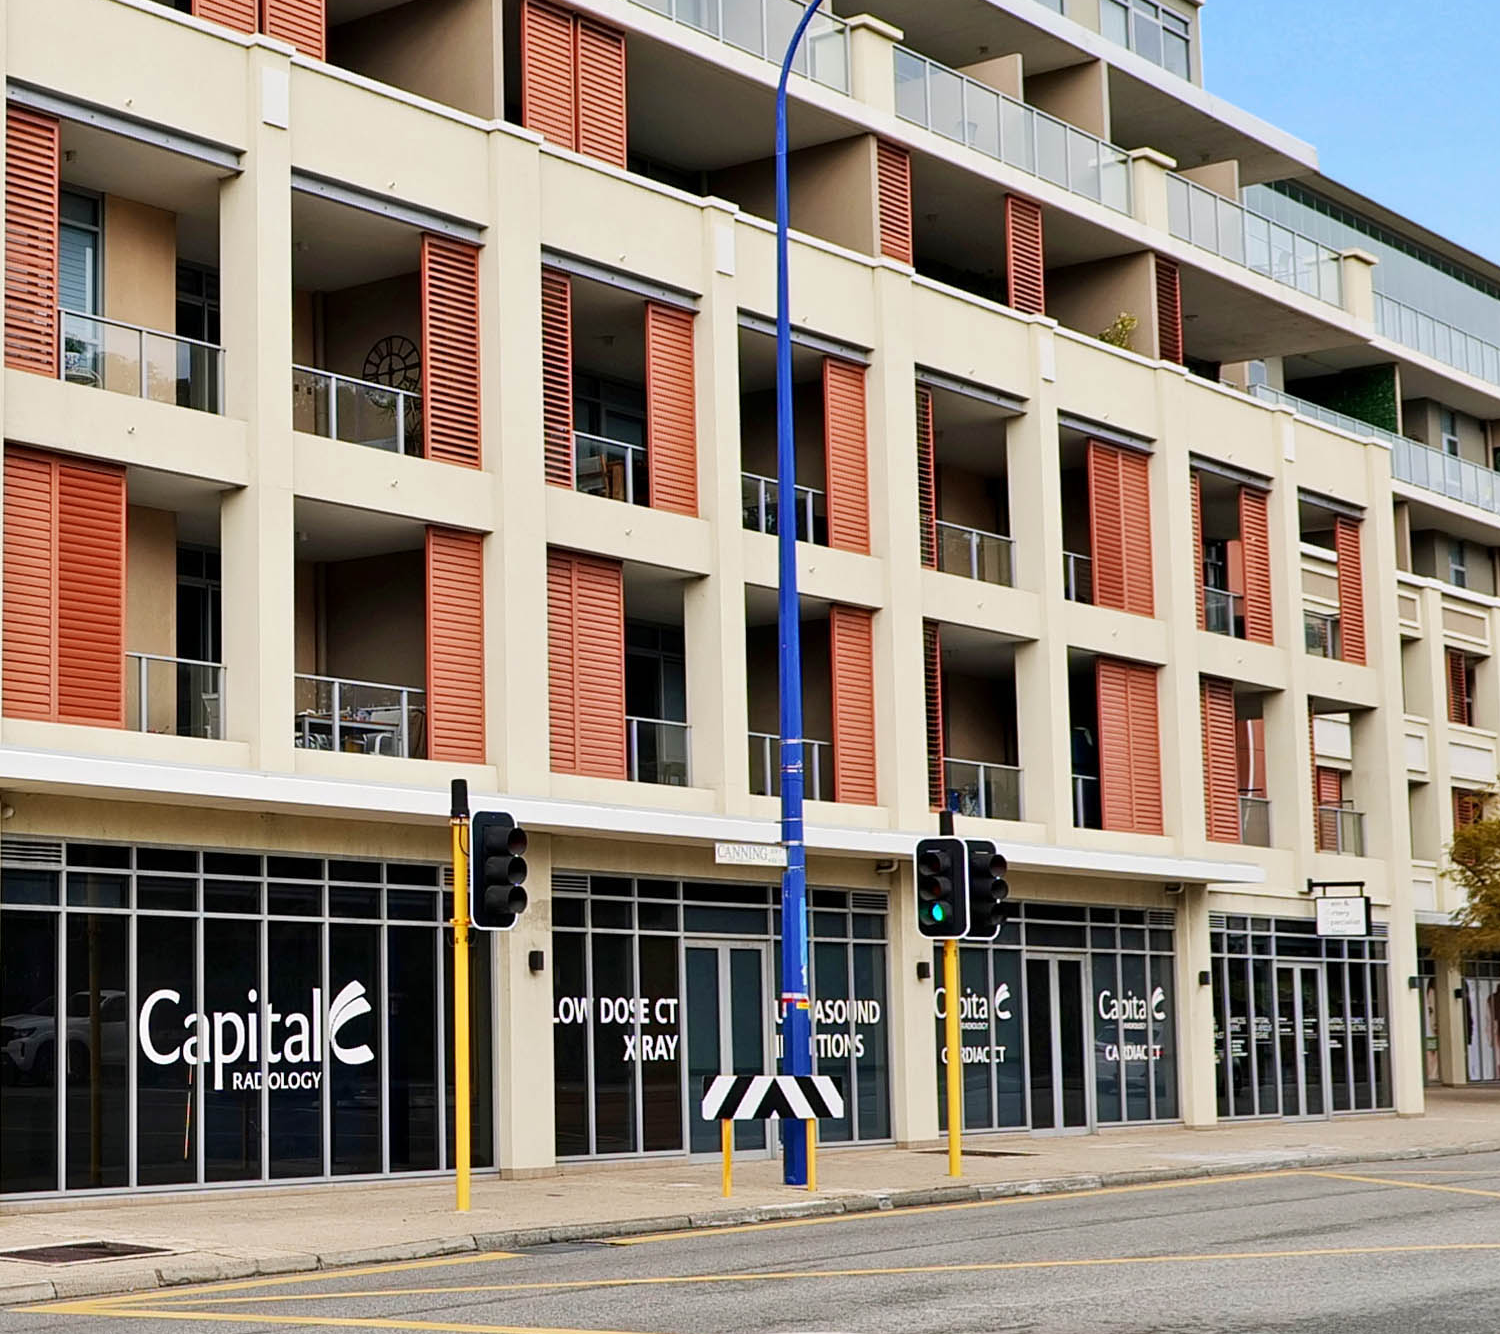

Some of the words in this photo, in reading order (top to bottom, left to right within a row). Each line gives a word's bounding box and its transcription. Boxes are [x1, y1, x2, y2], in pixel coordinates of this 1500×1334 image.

[718, 845, 768, 860] CANNING
[654, 997, 679, 1024] CT
[774, 999, 881, 1024] UASOUND
[139, 987, 322, 1091] Capital
[232, 1072, 322, 1091] RADOLOGY
